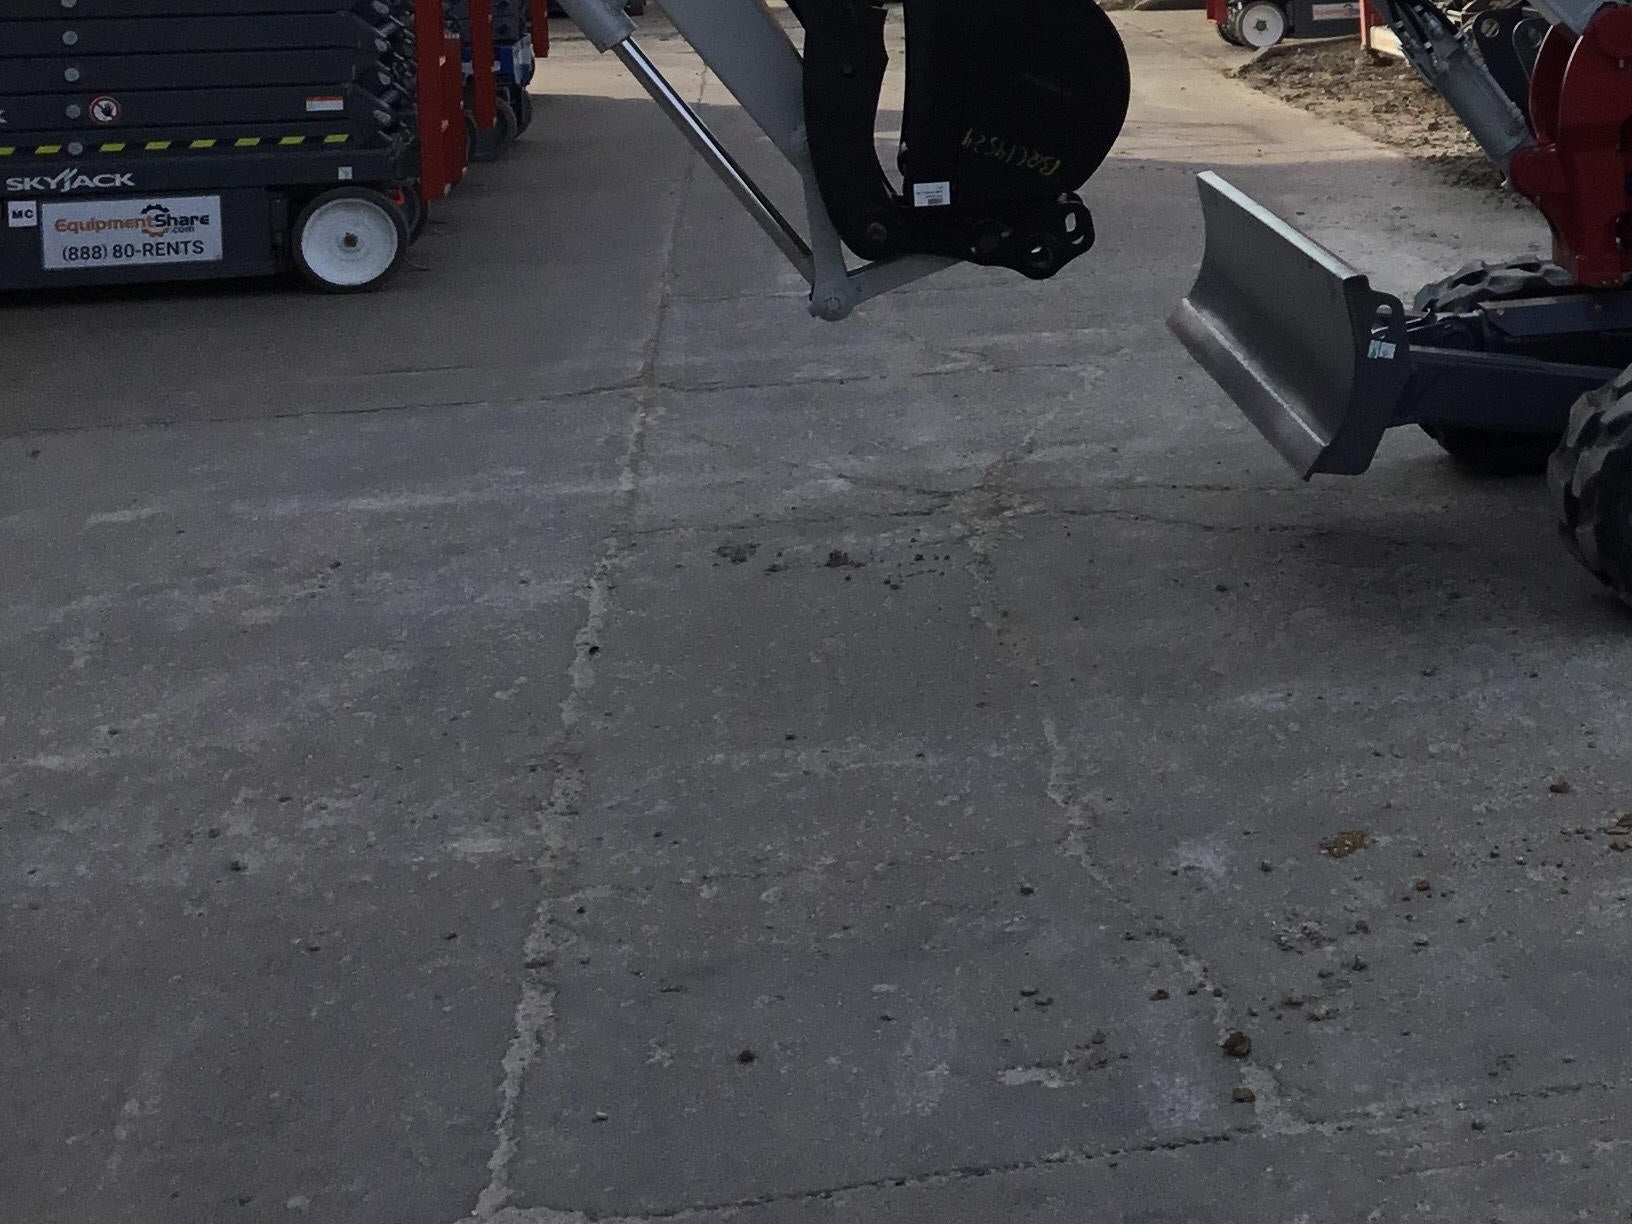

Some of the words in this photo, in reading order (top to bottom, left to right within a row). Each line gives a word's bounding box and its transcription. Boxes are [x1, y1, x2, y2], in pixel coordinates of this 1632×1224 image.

[5, 168, 136, 193] SKYJACK
[11, 209, 34, 219] MC
[54, 214, 210, 234] EquipmentShare
[62, 244, 108, 262] (888)
[112, 240, 204, 258] 80-RENTS
